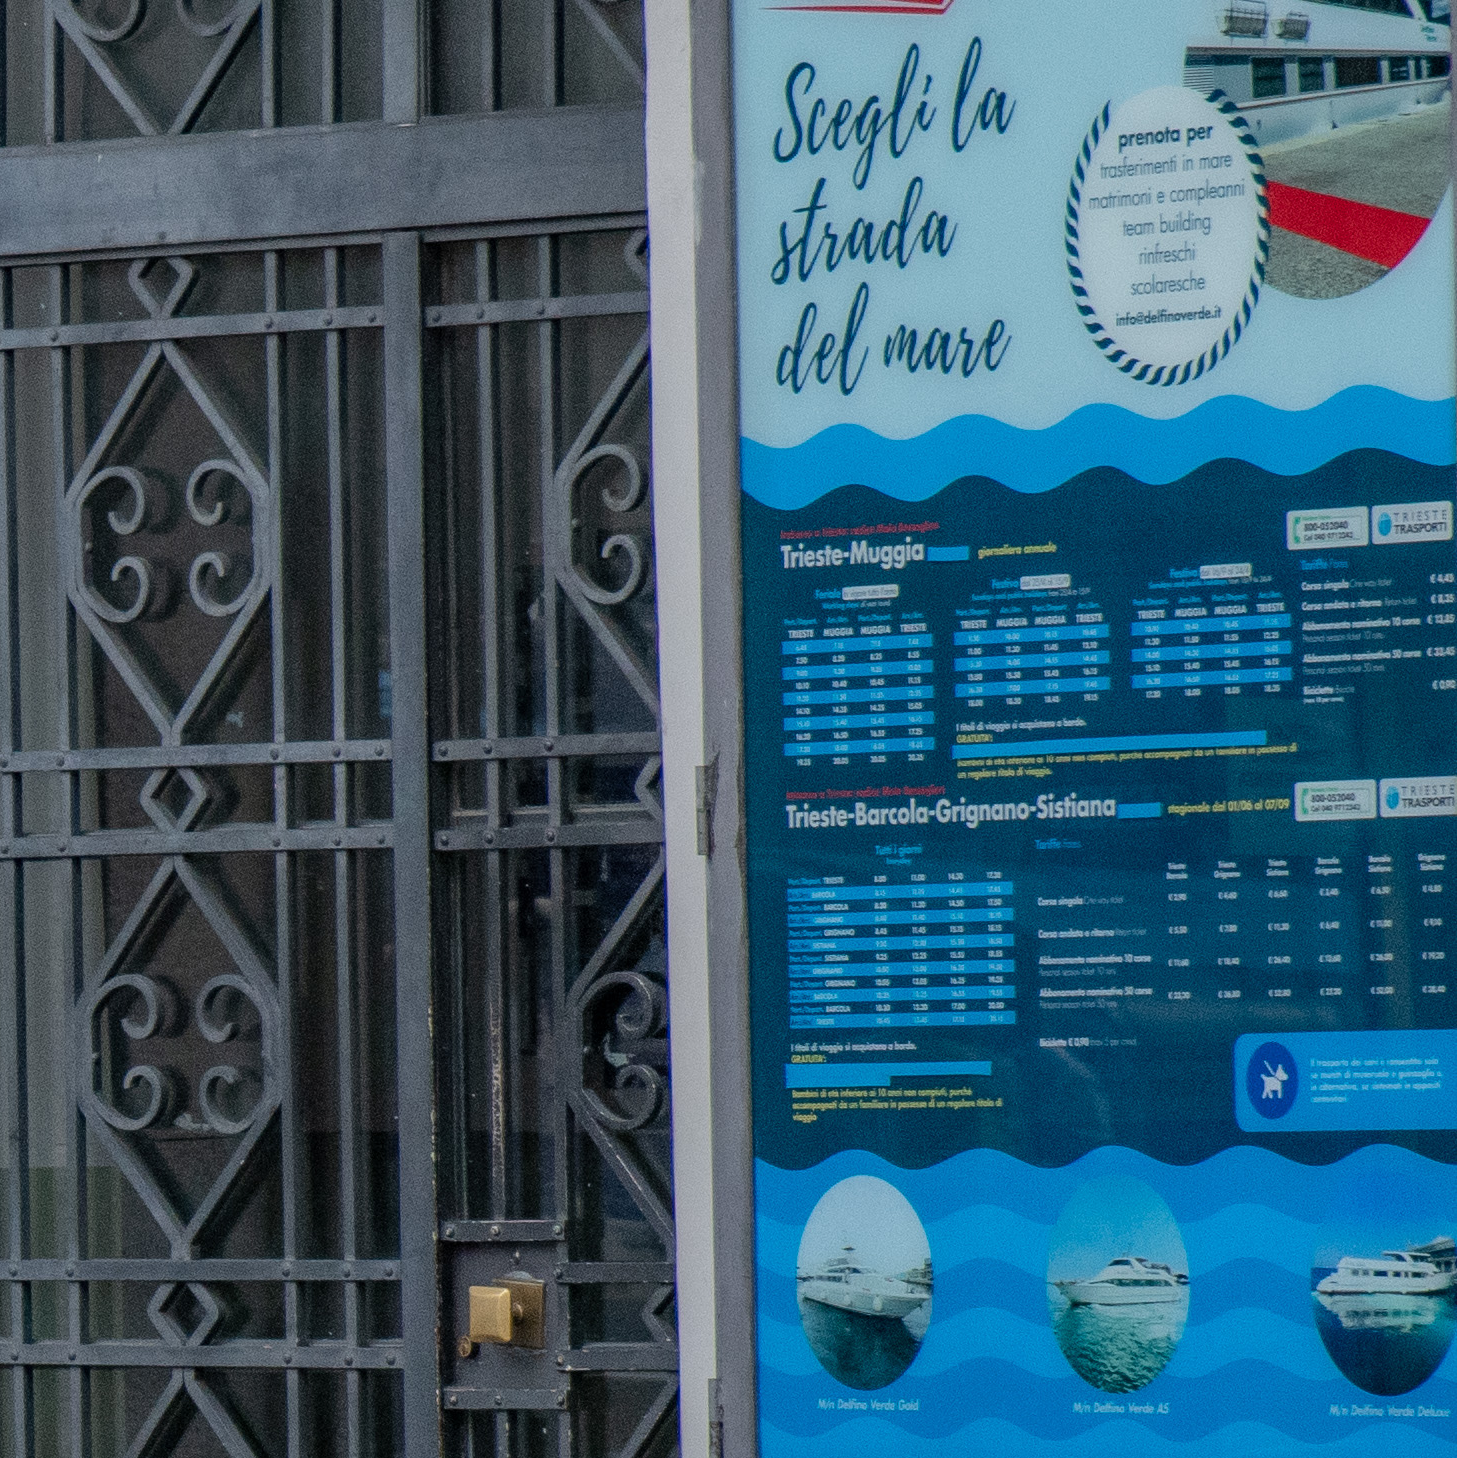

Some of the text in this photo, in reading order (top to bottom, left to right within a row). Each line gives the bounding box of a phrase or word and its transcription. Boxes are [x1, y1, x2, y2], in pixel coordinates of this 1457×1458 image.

[773, 36, 1015, 188] Scegli la
[1118, 125, 1214, 153] prenota per
[1100, 154, 1232, 179] trasferimenti in mare
[1089, 178, 1245, 210] matrimoni e compleanni
[770, 176, 958, 286] strada
[1123, 210, 1211, 237] team building
[1139, 243, 1196, 265] rinfreschi
[1130, 270, 1206, 296] scolaresche
[775, 282, 1013, 396] del mare
[1393, 509, 1448, 522] TRIESTE
[1393, 521, 1448, 534] TRASPORTI
[780, 536, 925, 570] Trieste-Muggia
[1401, 784, 1456, 796] TRIESTE
[1401, 796, 1456, 808] TRASPORTI
[785, 792, 1117, 829] Trieste-Barcola-Grignano-Sistiana
[1226, 800, 1252, 813] 01/06
[1264, 798, 1291, 811] 07/09
[837, 1398, 868, 1410] Delfino
